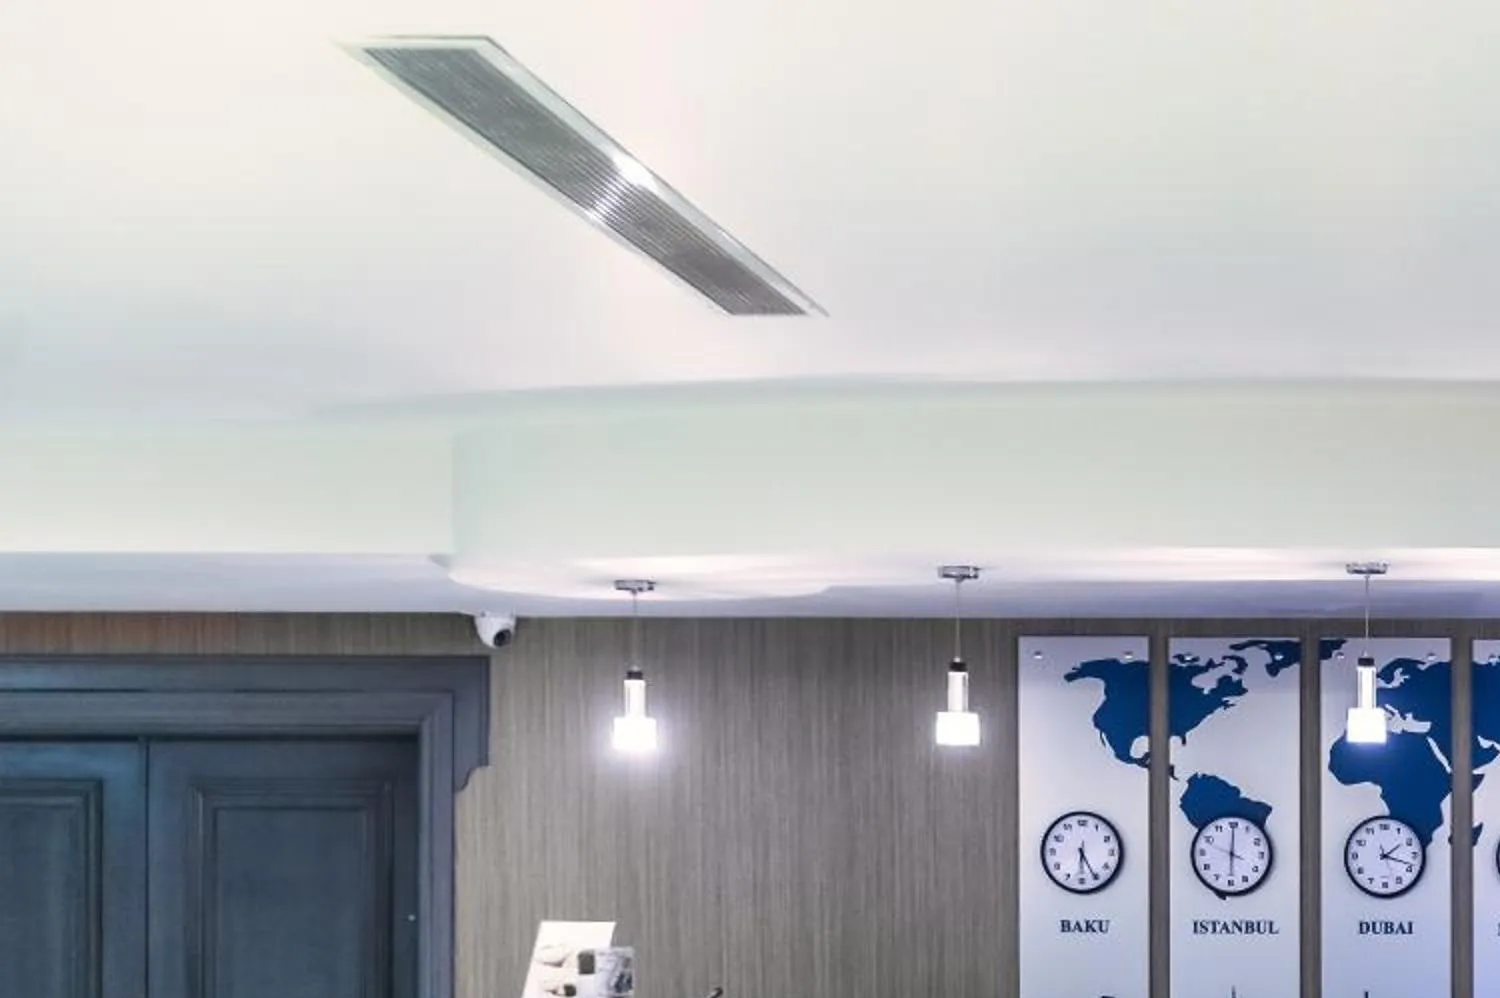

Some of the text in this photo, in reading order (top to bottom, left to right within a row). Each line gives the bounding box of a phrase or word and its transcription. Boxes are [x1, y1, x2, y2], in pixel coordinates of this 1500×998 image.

[1060, 920, 1110, 933] BAKU
[1192, 920, 1279, 934] ISTANBUL
[1358, 921, 1414, 935] DUBAI
